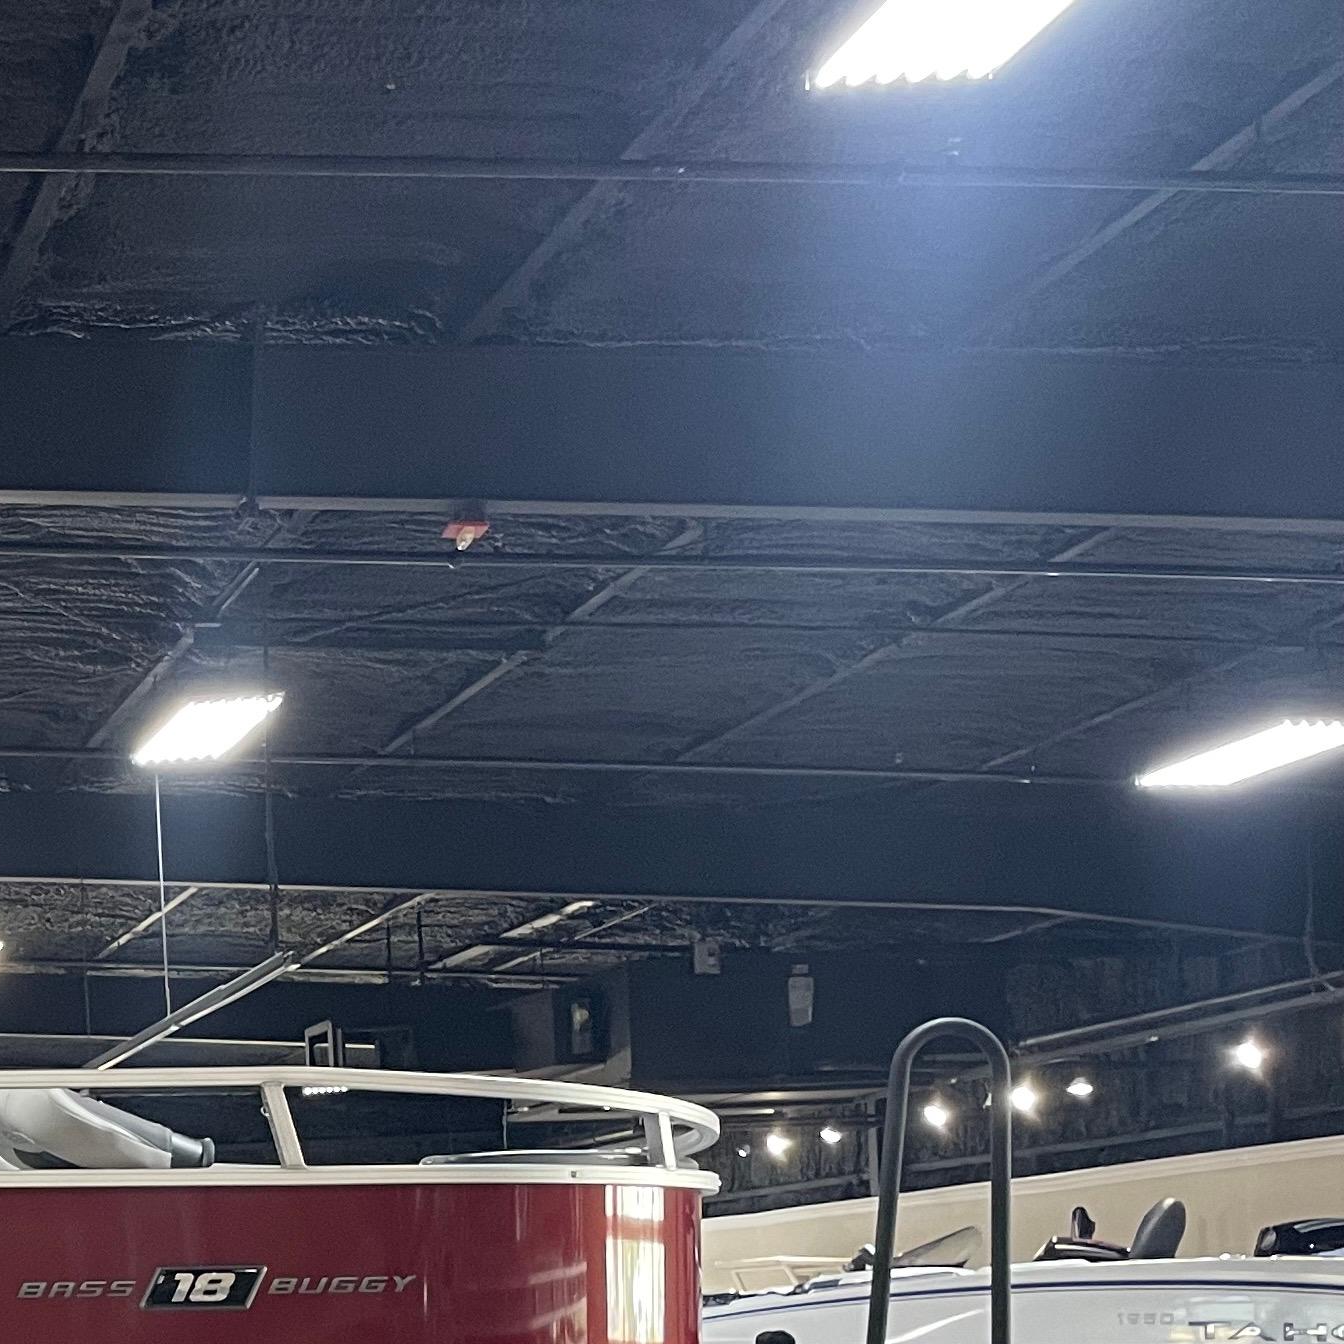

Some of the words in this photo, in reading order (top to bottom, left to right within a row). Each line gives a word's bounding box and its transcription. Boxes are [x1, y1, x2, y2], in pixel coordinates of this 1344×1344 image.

[16, 1280, 137, 1299] BASS
[170, 1272, 236, 1303] 18
[267, 1275, 417, 1296] BUGGY
